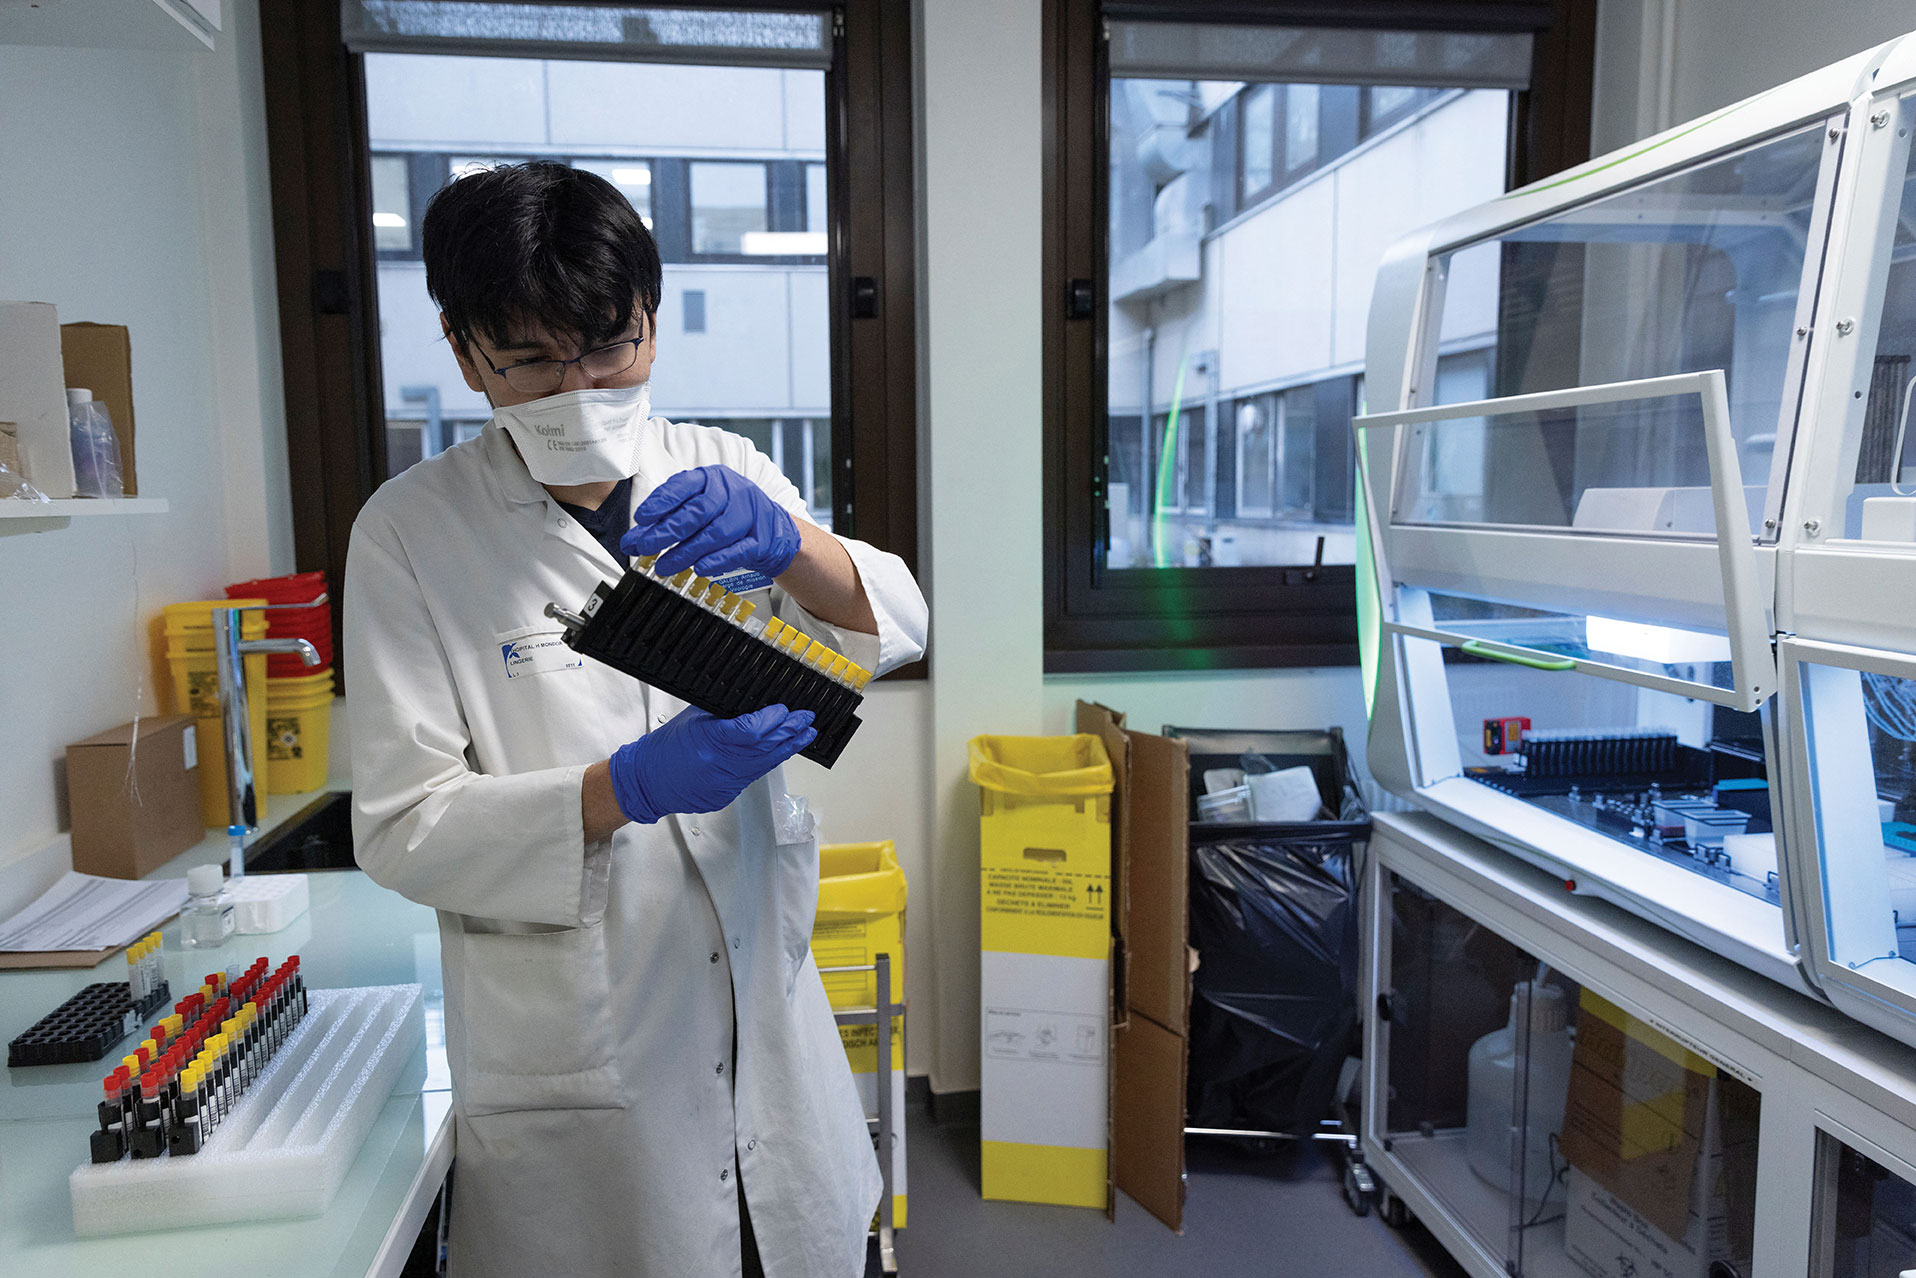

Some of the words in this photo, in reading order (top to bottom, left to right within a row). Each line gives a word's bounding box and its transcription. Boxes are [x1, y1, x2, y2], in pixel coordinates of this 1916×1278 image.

[534, 424, 565, 437] Kolmi
[588, 598, 598, 611] 3
[512, 644, 534, 653] HOPITAL
[510, 657, 534, 666] LINGERIE
